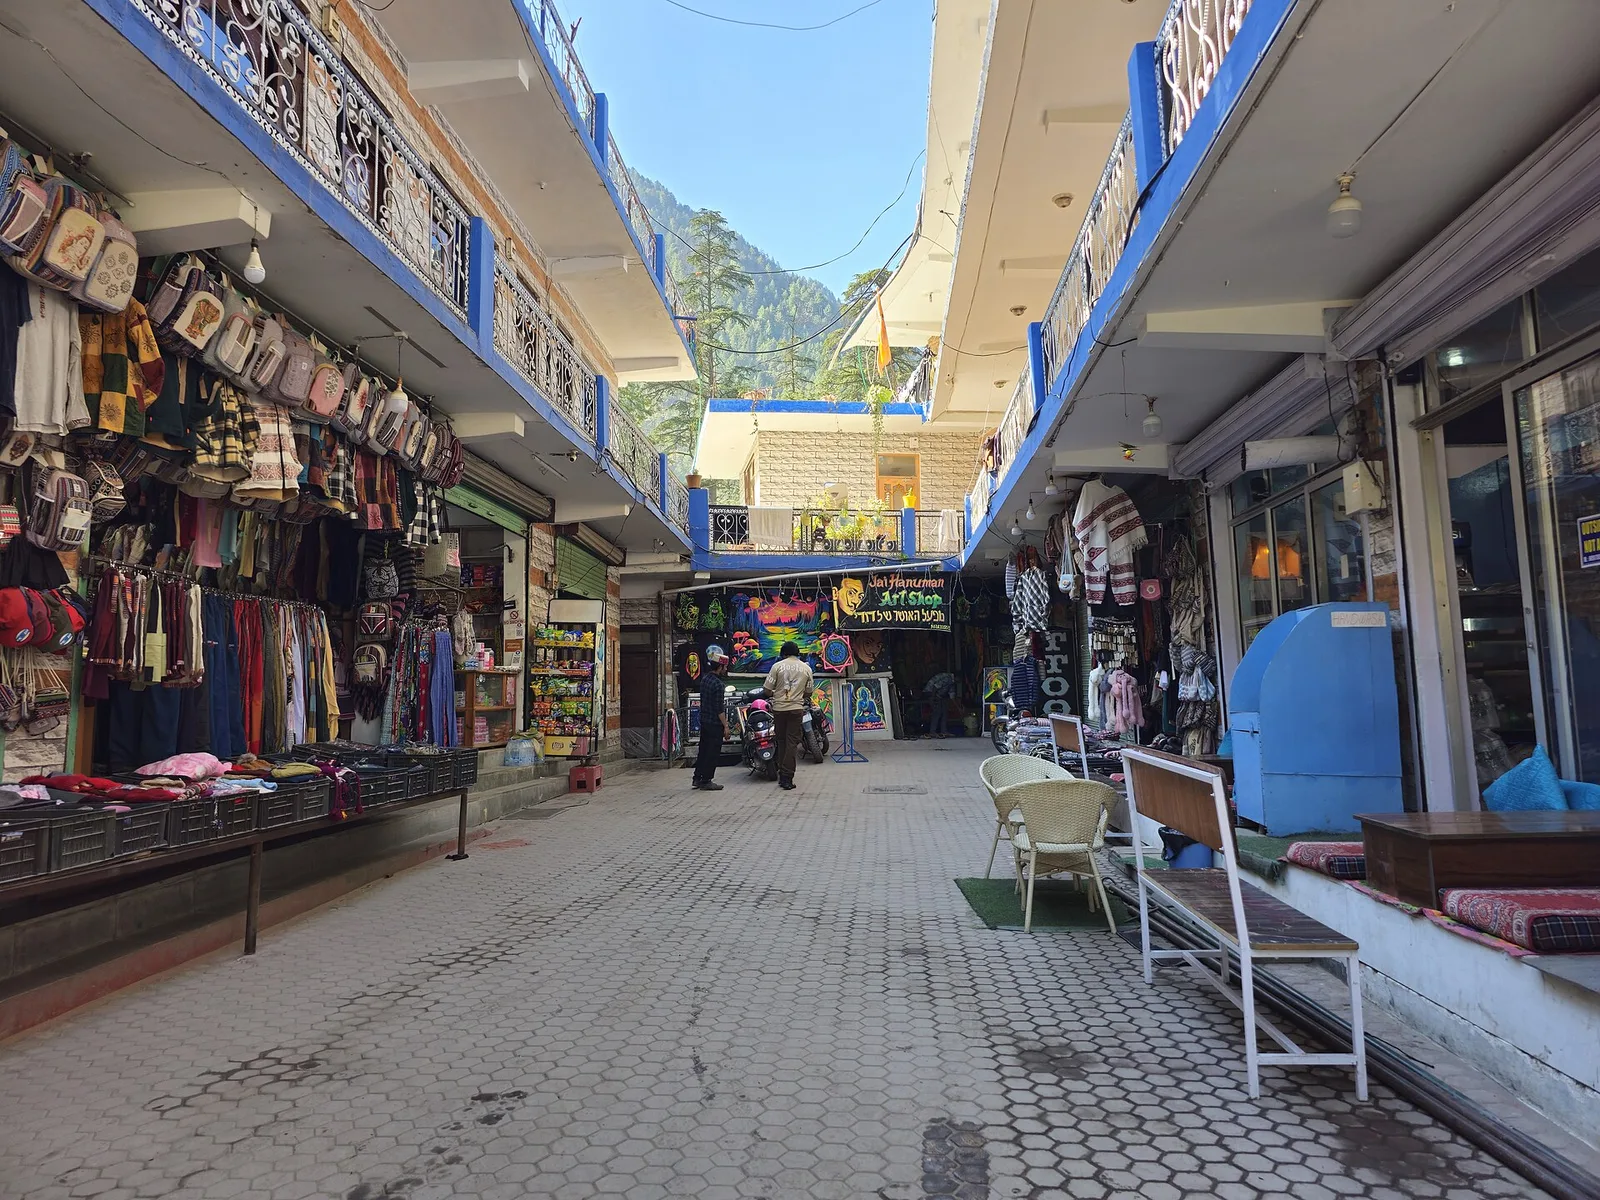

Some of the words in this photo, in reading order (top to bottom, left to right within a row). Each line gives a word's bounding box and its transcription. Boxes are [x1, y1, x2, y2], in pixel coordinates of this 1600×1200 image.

[869, 574, 888, 588] Jai
[888, 573, 945, 590] Hanuman
[878, 590, 907, 607] Art
[908, 591, 943, 609] Shop
